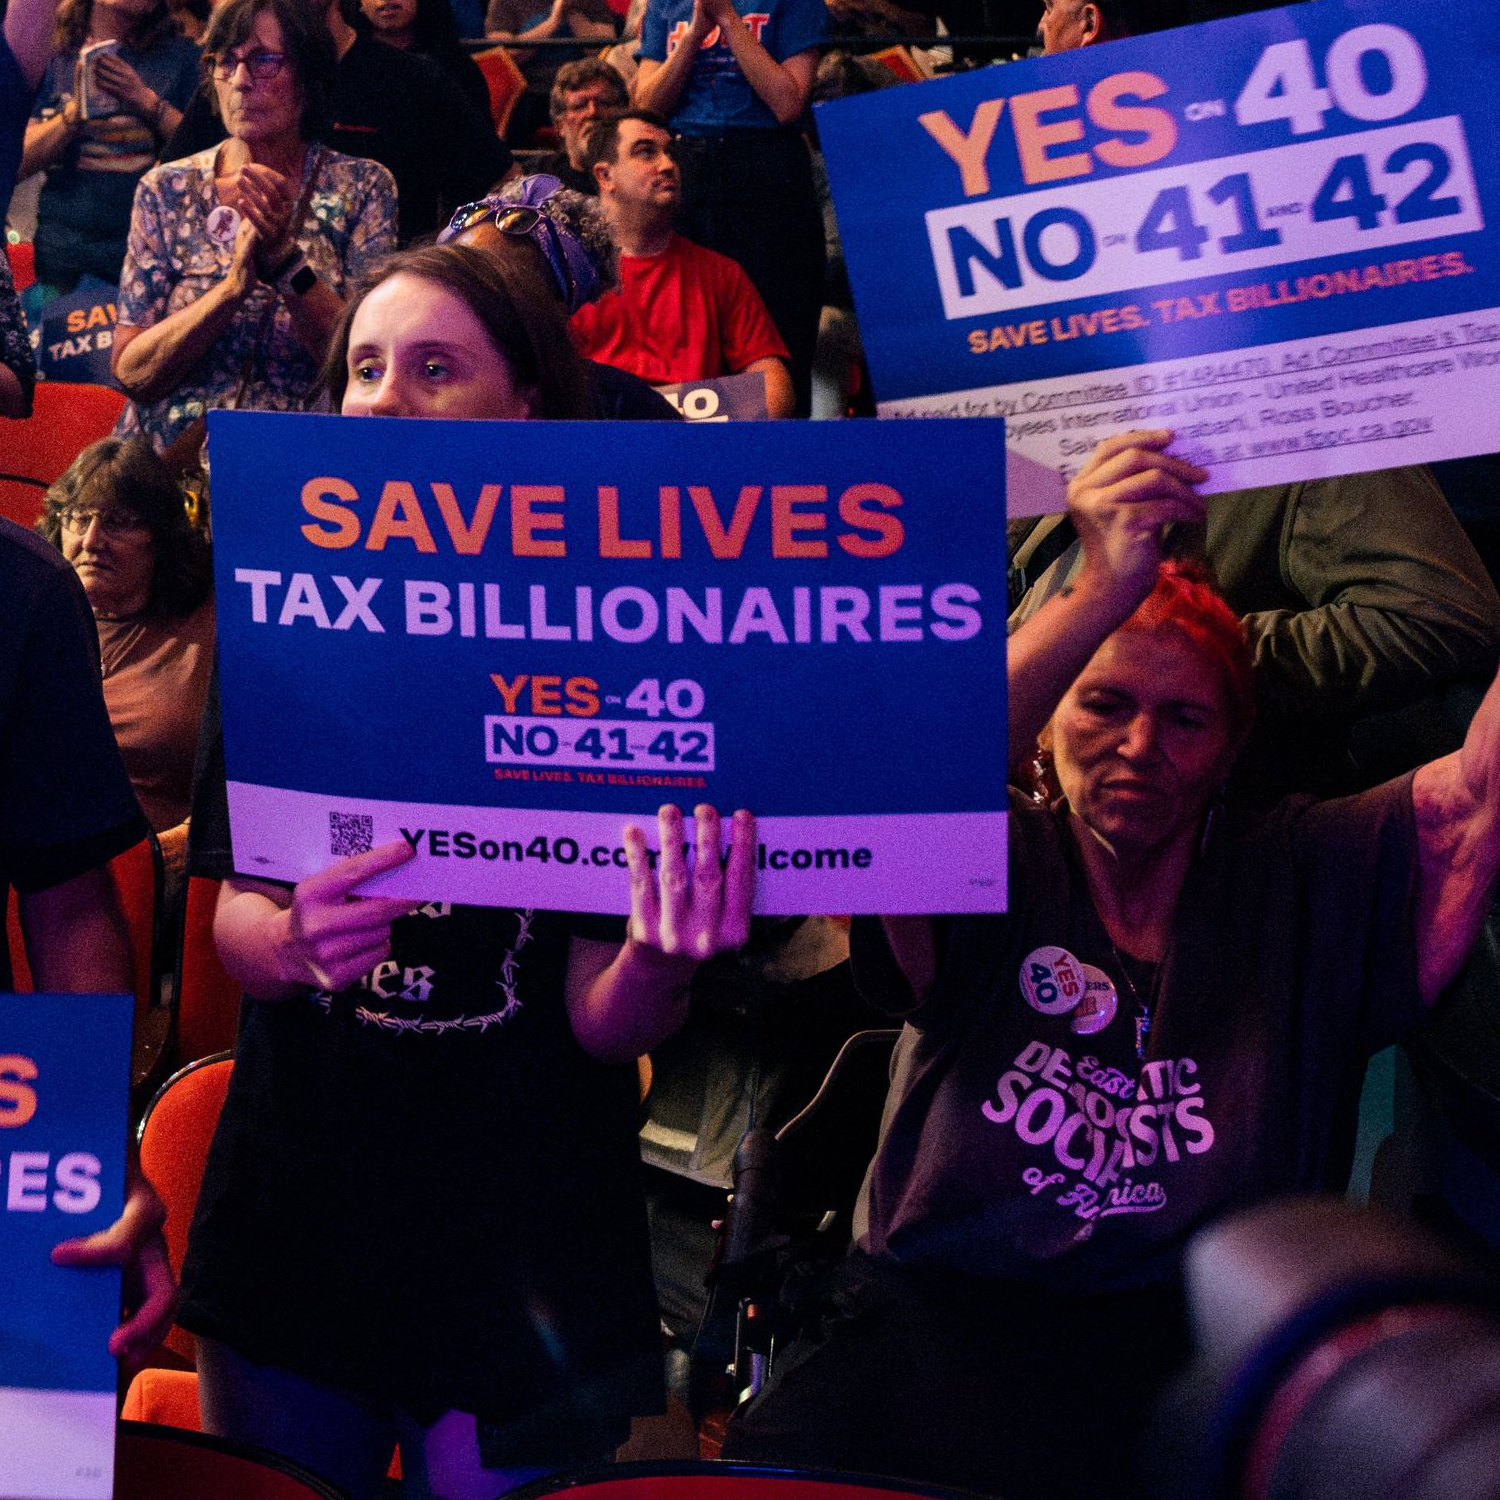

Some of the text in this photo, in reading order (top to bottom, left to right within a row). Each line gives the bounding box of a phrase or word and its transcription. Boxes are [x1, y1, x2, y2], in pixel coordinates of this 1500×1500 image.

[919, 23, 1427, 197] YES ON 40
[945, 206, 1098, 298] NO
[1133, 171, 1281, 262] 41
[1308, 141, 1462, 231] 42
[968, 251, 1475, 355] SAVE LIVES. TAX BILLIONAIRES.
[49, 334, 92, 361] TAX
[1021, 381, 1128, 412] Committee
[300, 477, 904, 560] SAVE LIVES
[234, 568, 984, 644] TAX BILLIONAIRES
[489, 673, 600, 717] YES
[626, 678, 705, 718] 40
[493, 723, 559, 756] NO
[574, 728, 634, 761] 41
[648, 730, 708, 763] 42
[494, 768, 530, 781] SAVE
[577, 771, 605, 785] TAX
[1030, 963, 1058, 1004] 40
[1054, 953, 1079, 997] YES
[1022, 1167, 1066, 1195] of
